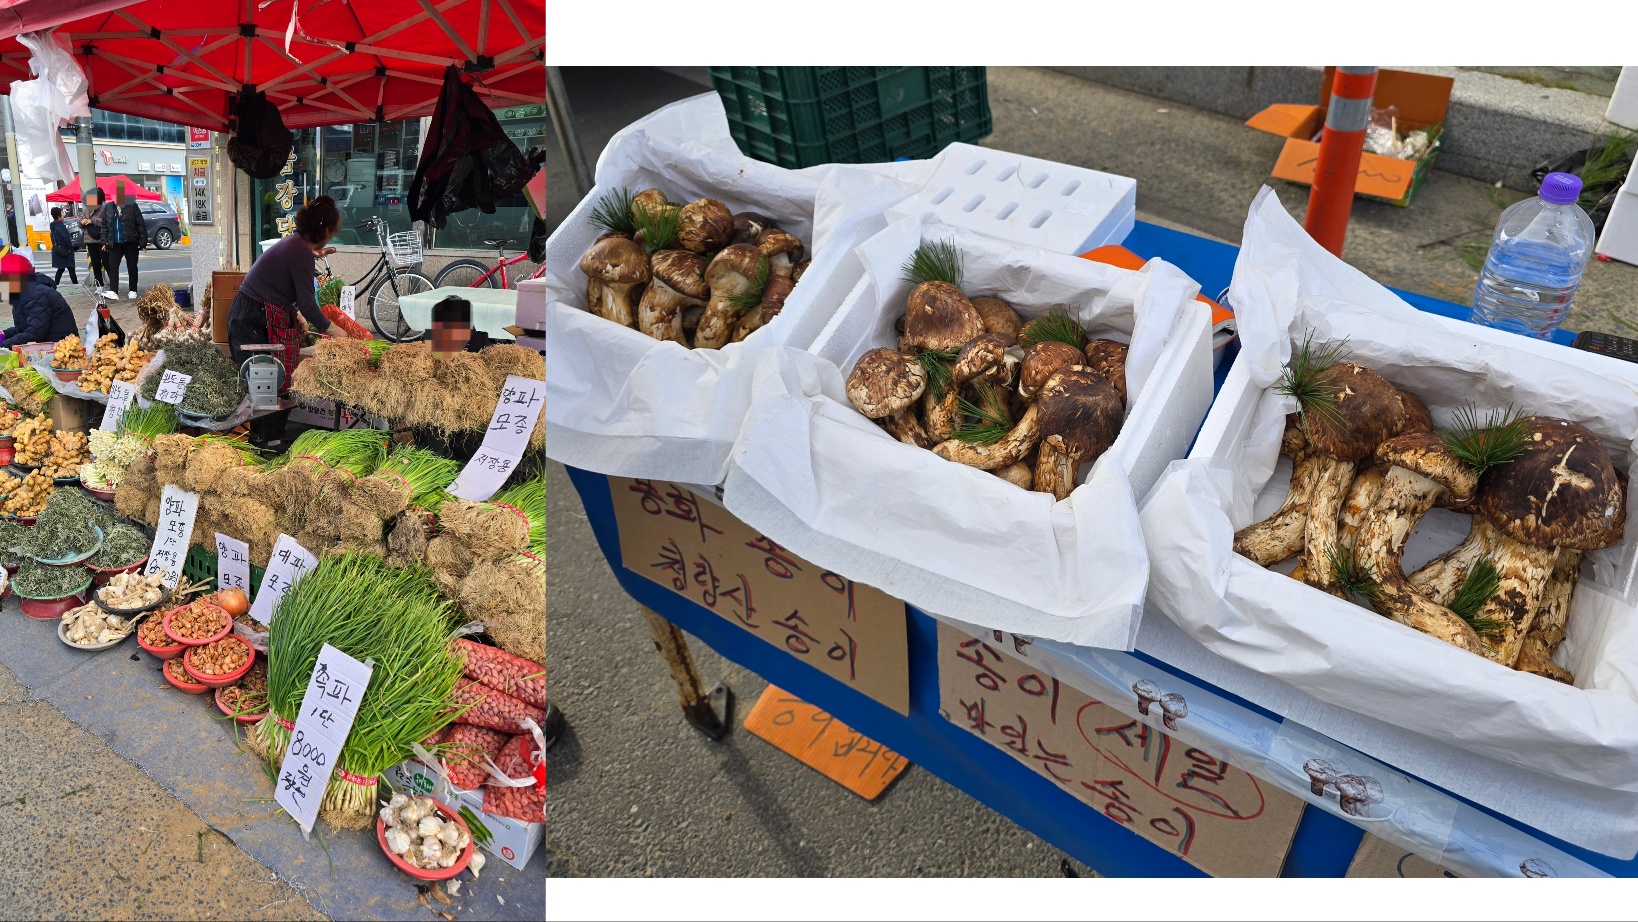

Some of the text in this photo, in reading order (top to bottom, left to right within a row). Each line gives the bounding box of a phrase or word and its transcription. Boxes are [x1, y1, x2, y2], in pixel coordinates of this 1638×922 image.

[193, 168, 206, 177] 치금
[194, 188, 206, 197] 14K
[195, 199, 207, 209] 18K
[195, 211, 207, 221] 순금
[502, 387, 540, 408] 양파
[490, 413, 528, 434] 모종
[474, 453, 511, 472] 저장용
[166, 496, 185, 517] 양파
[168, 521, 185, 537] 모종
[156, 550, 177, 566] 저장용
[219, 541, 247, 564] 양파
[279, 549, 306, 570] 대파
[745, 535, 856, 622] 송이
[651, 538, 857, 681] 청량산 송이
[310, 707, 335, 729] 1단
[956, 638, 1242, 818] 송이 세일
[292, 730, 326, 767] 8000
[298, 763, 313, 787] 원
[1081, 780, 1196, 860] 송이
